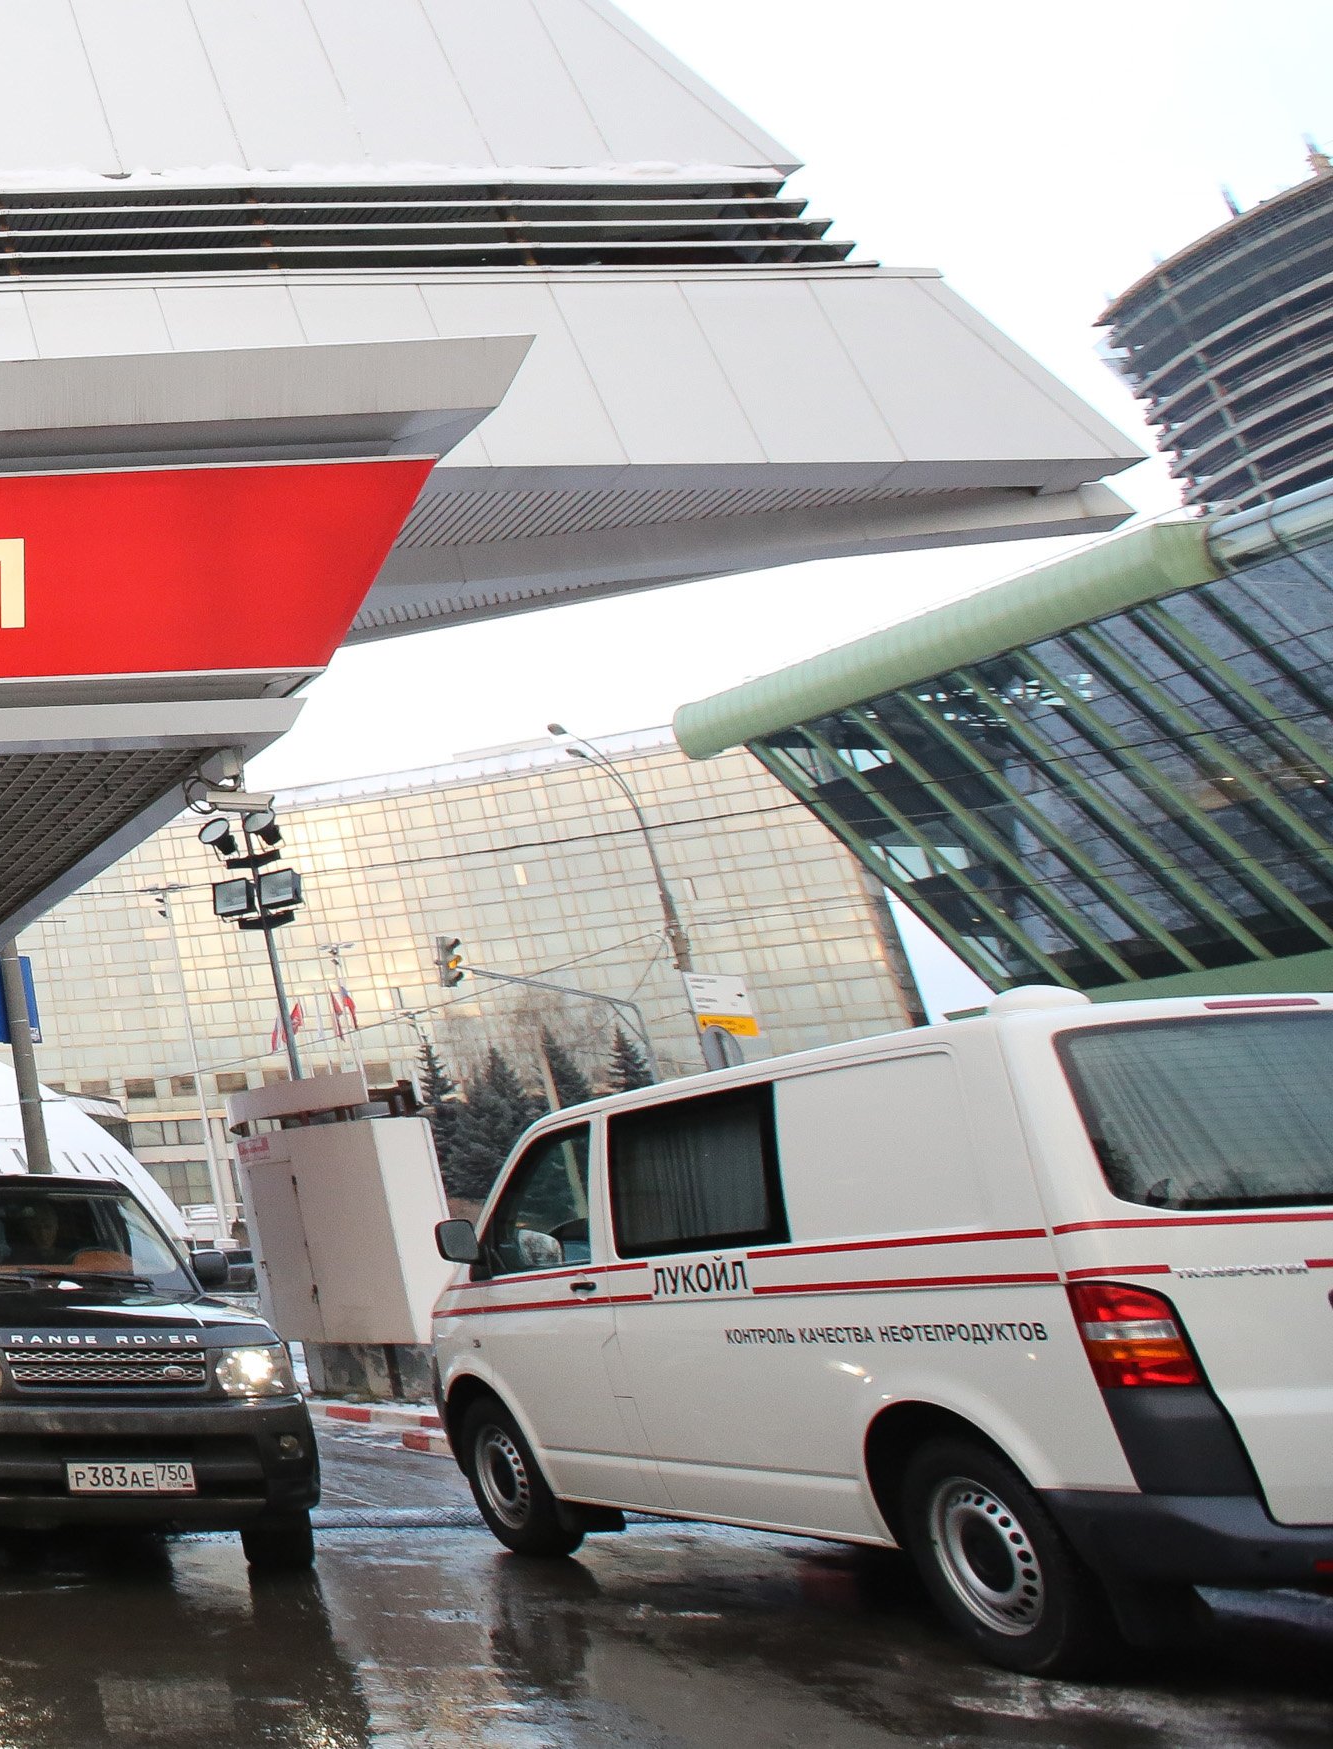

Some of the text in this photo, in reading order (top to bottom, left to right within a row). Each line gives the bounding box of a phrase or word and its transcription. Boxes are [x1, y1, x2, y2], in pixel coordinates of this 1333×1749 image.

[654, 1255, 748, 1295] ЛУКОЙЛ
[11, 1334, 199, 1344] RANGE ROVER
[724, 1321, 1049, 1345] КОНТРОЛЬ КАЧЕСТВА НЕФТЕПРОДУКТОВ
[75, 1464, 188, 1488] Р383АЕ 750
